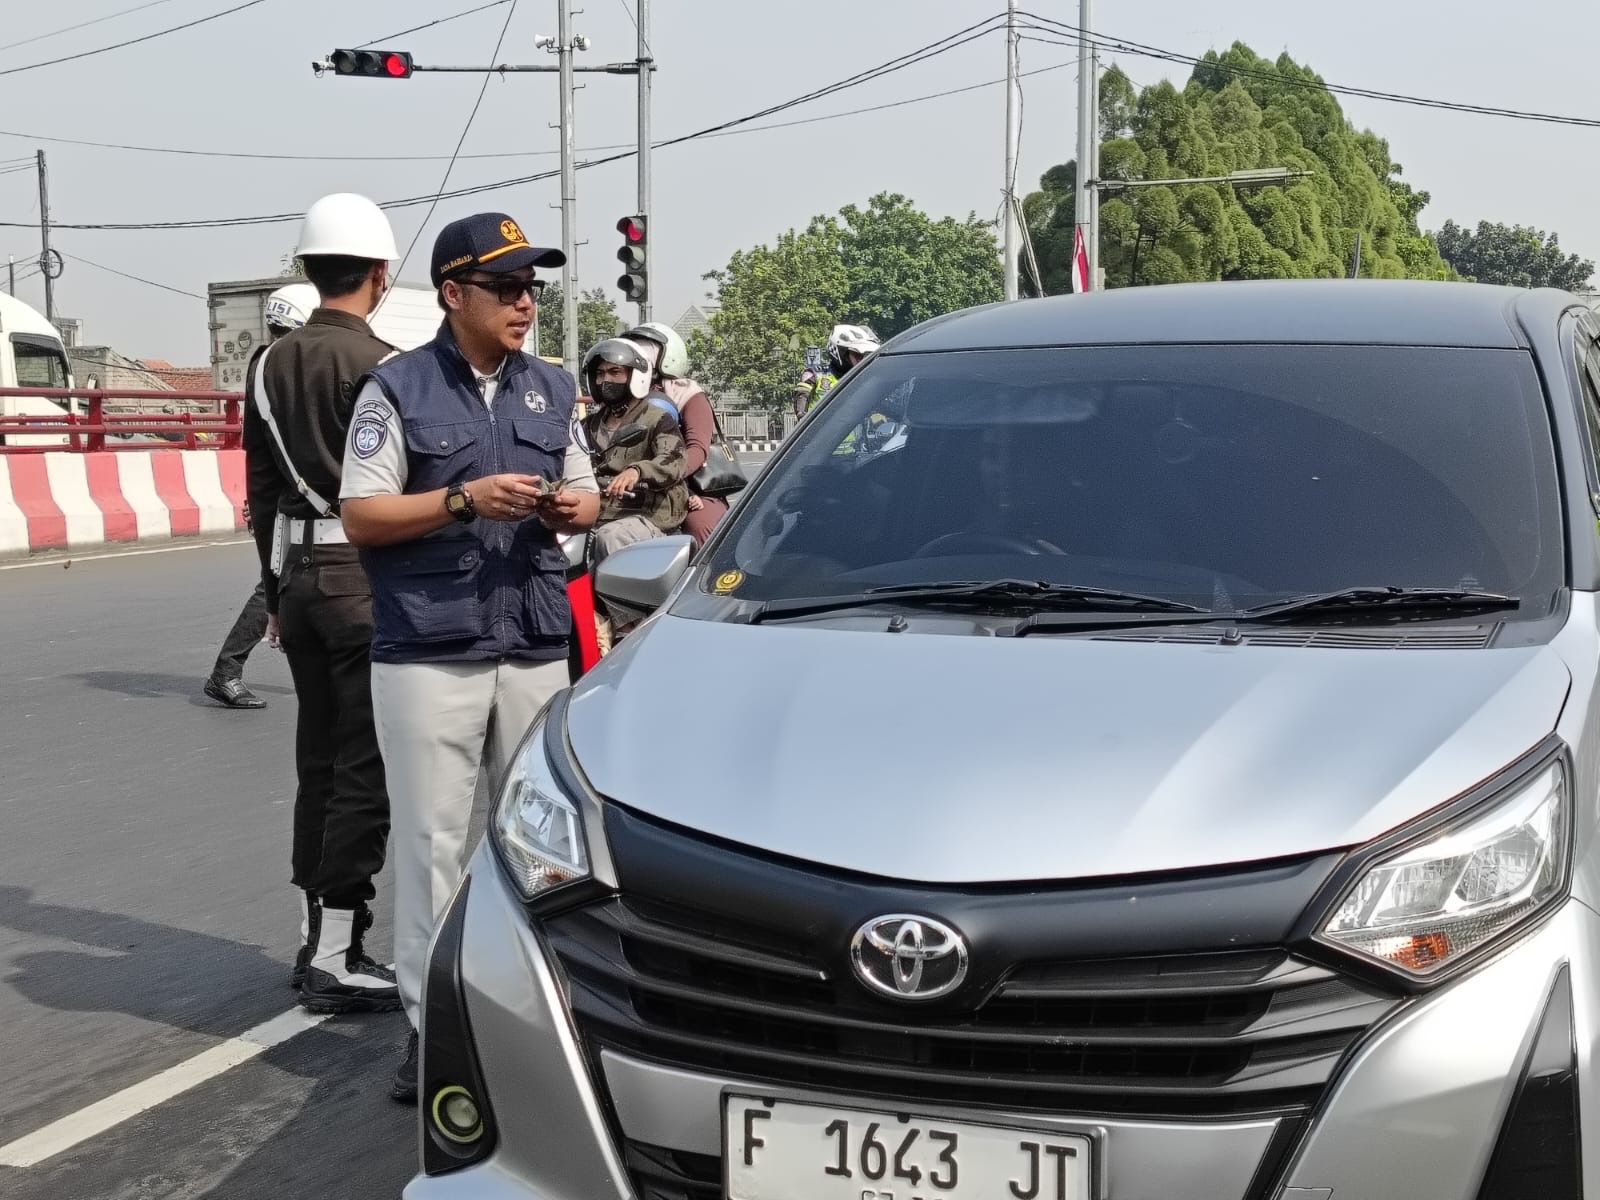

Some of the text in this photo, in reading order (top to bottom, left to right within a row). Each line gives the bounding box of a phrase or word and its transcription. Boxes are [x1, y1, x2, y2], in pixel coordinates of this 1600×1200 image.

[744, 1108, 1077, 1200] F 1643 JT
